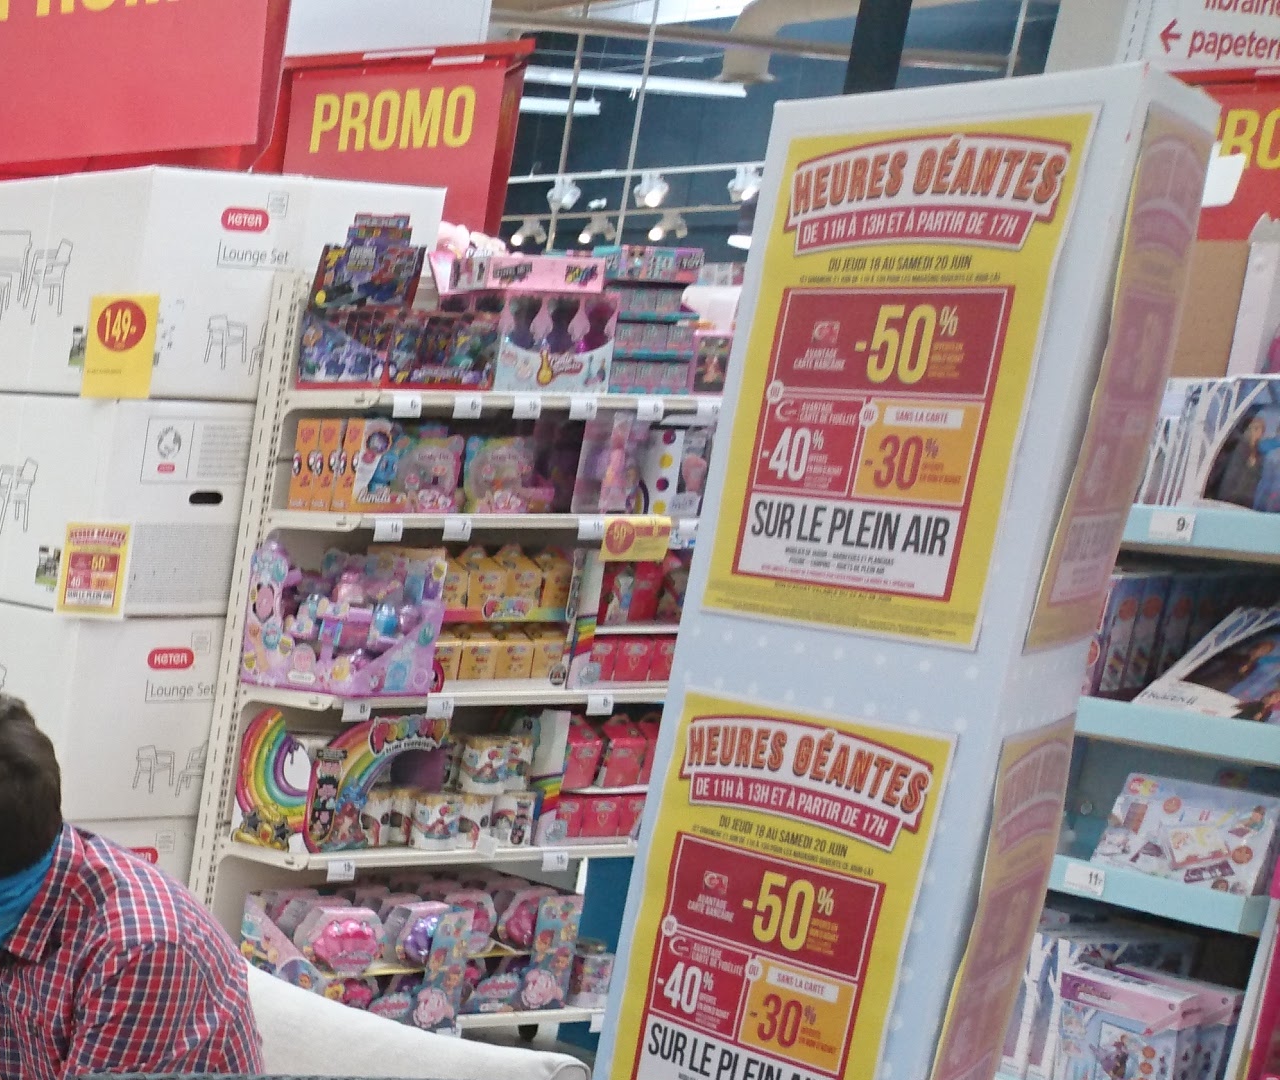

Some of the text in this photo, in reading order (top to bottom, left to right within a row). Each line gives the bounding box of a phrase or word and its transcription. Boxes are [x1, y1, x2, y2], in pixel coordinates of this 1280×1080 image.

[309, 84, 477, 154] PROMO
[792, 136, 1068, 217] HEURES GÉANTES
[228, 214, 263, 228] KETER
[802, 208, 1021, 244] DE 11H À 13H ET À PARTIR DE 17H
[222, 246, 289, 268] Lounge Set
[828, 254, 973, 272] DU JEUDI 18 AU SAMEDI 20 JUIN
[854, 303, 959, 385] -50%
[761, 427, 825, 481] -40%
[864, 434, 939, 490] -30%
[751, 500, 795, 540] SUR
[796, 504, 827, 543] LE
[827, 507, 901, 552] PLEIN
[901, 514, 951, 557] AIR
[153, 653, 188, 666] KETER
[150, 683, 216, 700] Lounge Set
[688, 725, 930, 815] HEURES GÉANTES
[695, 777, 889, 838] DE 11H À 13H ET À PARTIR DE 17H
[719, 814, 848, 858] DU JEUDI AU SAMEDI 20 JUIN
[742, 870, 836, 952] -50%
[657, 960, 714, 1014] -40%
[749, 993, 817, 1048] -30%
[648, 1022, 687, 1067] SUR
[688, 1038, 716, 1078] LE
